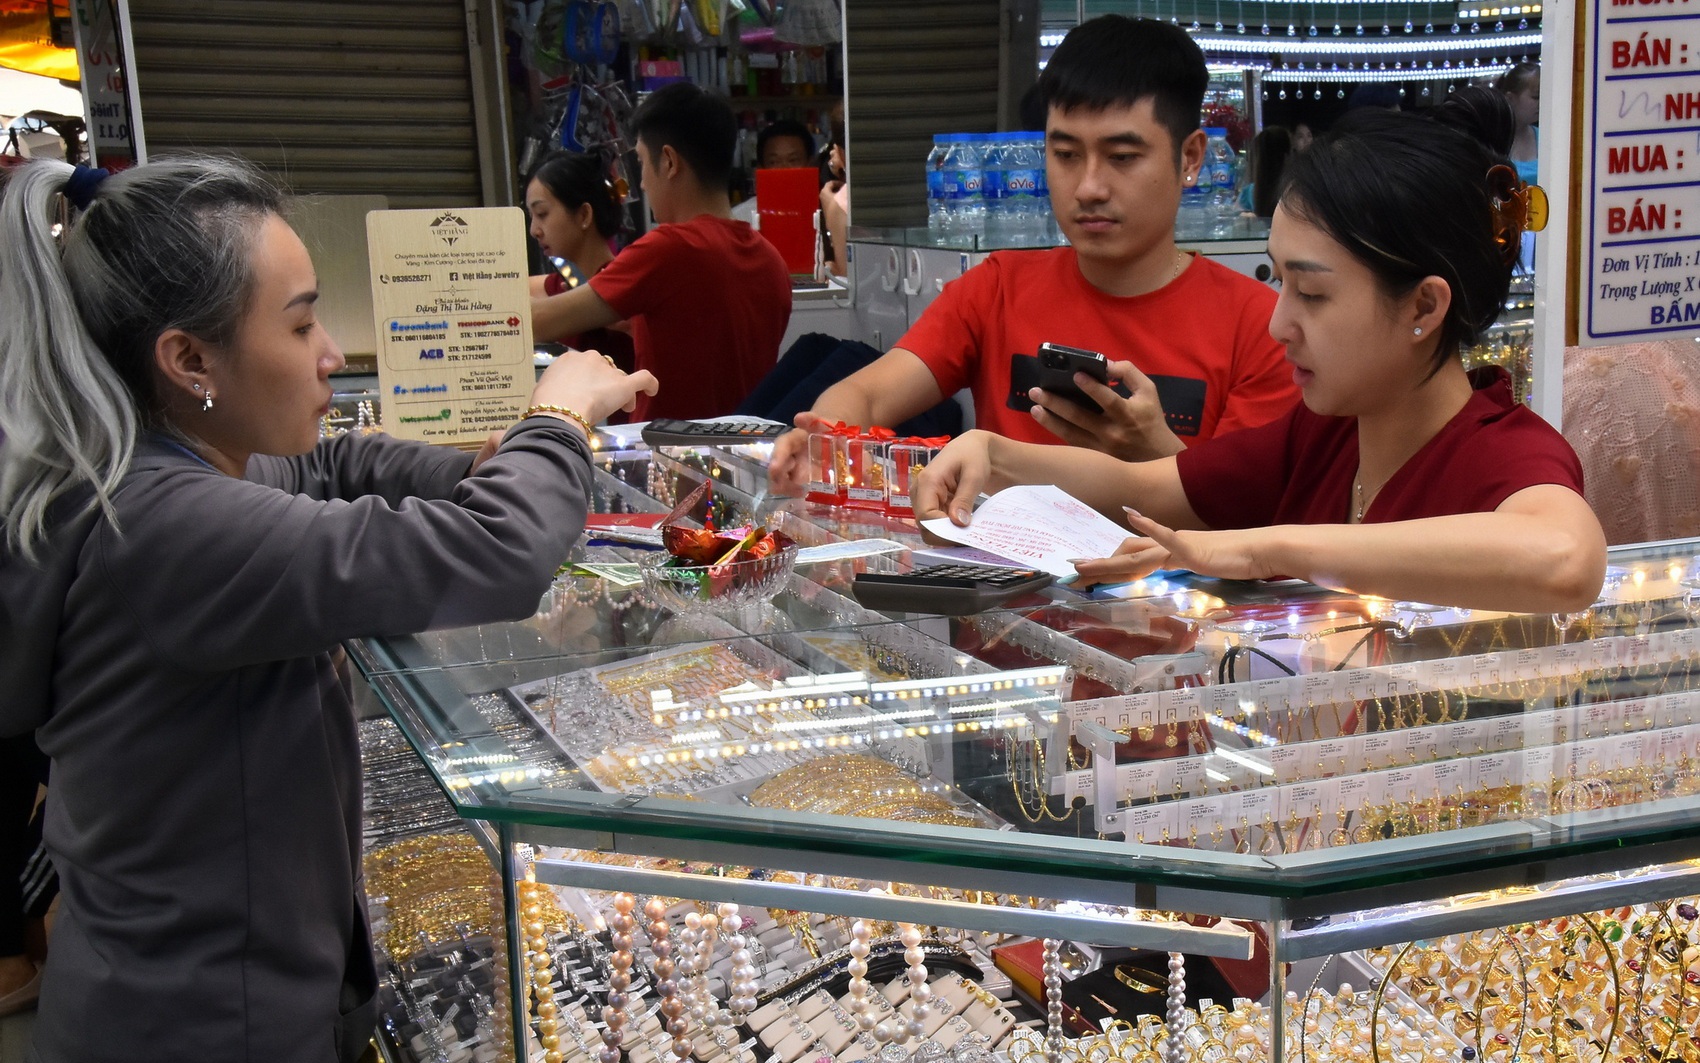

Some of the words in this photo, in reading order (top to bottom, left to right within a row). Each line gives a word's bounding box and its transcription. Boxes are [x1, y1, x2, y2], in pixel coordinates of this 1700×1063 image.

[1612, 31, 1671, 68] BÁN
[1608, 145, 1668, 174] MUA
[1008, 178, 1036, 190] laVie
[1608, 198, 1666, 234] BÁN
[1602, 258, 1630, 273] Đơn
[1635, 255, 1649, 273] Vị
[1653, 252, 1682, 269] Tính
[462, 272, 475, 281] Việt
[493, 271, 520, 280] Jewelry
[1600, 283, 1638, 301] Trọng
[1641, 281, 1681, 297] Lượng
[1684, 276, 1695, 292] X
[1650, 297, 1700, 325] BẤM
[419, 348, 444, 360] ACB
